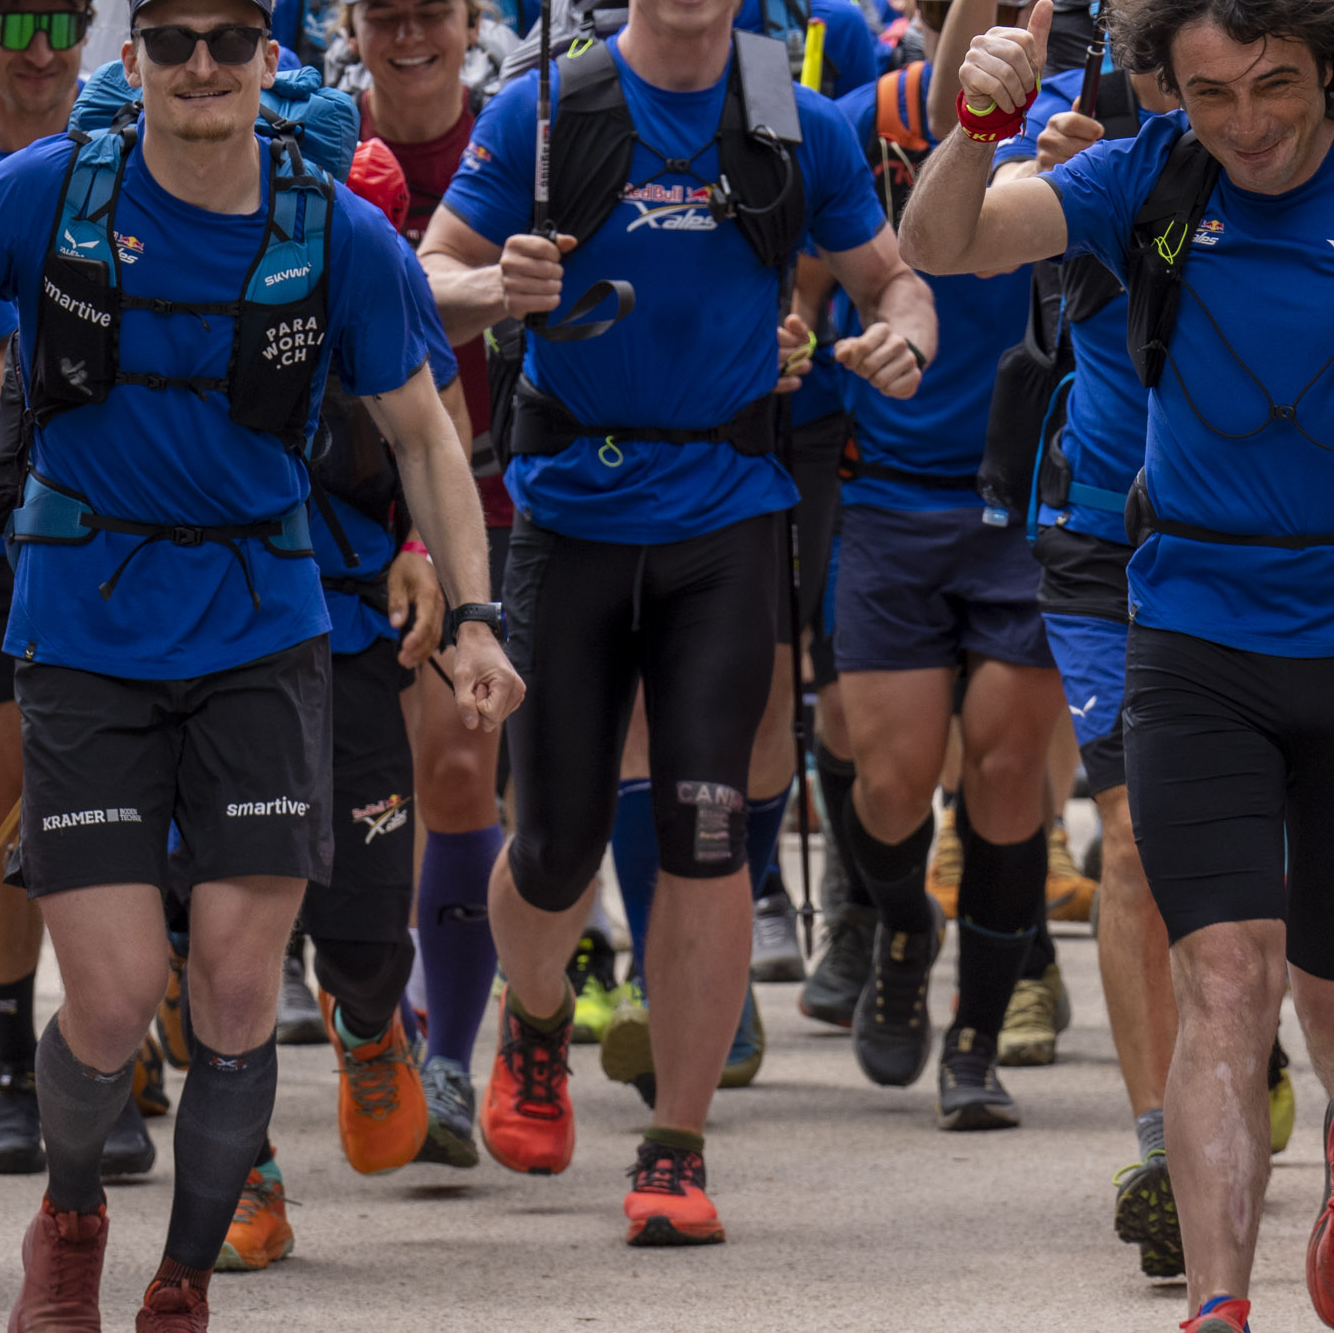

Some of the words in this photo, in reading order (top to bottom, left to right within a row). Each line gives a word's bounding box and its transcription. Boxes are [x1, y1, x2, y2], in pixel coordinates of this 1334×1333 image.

[44, 275, 112, 328] martive
[266, 316, 318, 343] PARA
[226, 796, 308, 817] smartive
[42, 809, 106, 832] KRAMER
